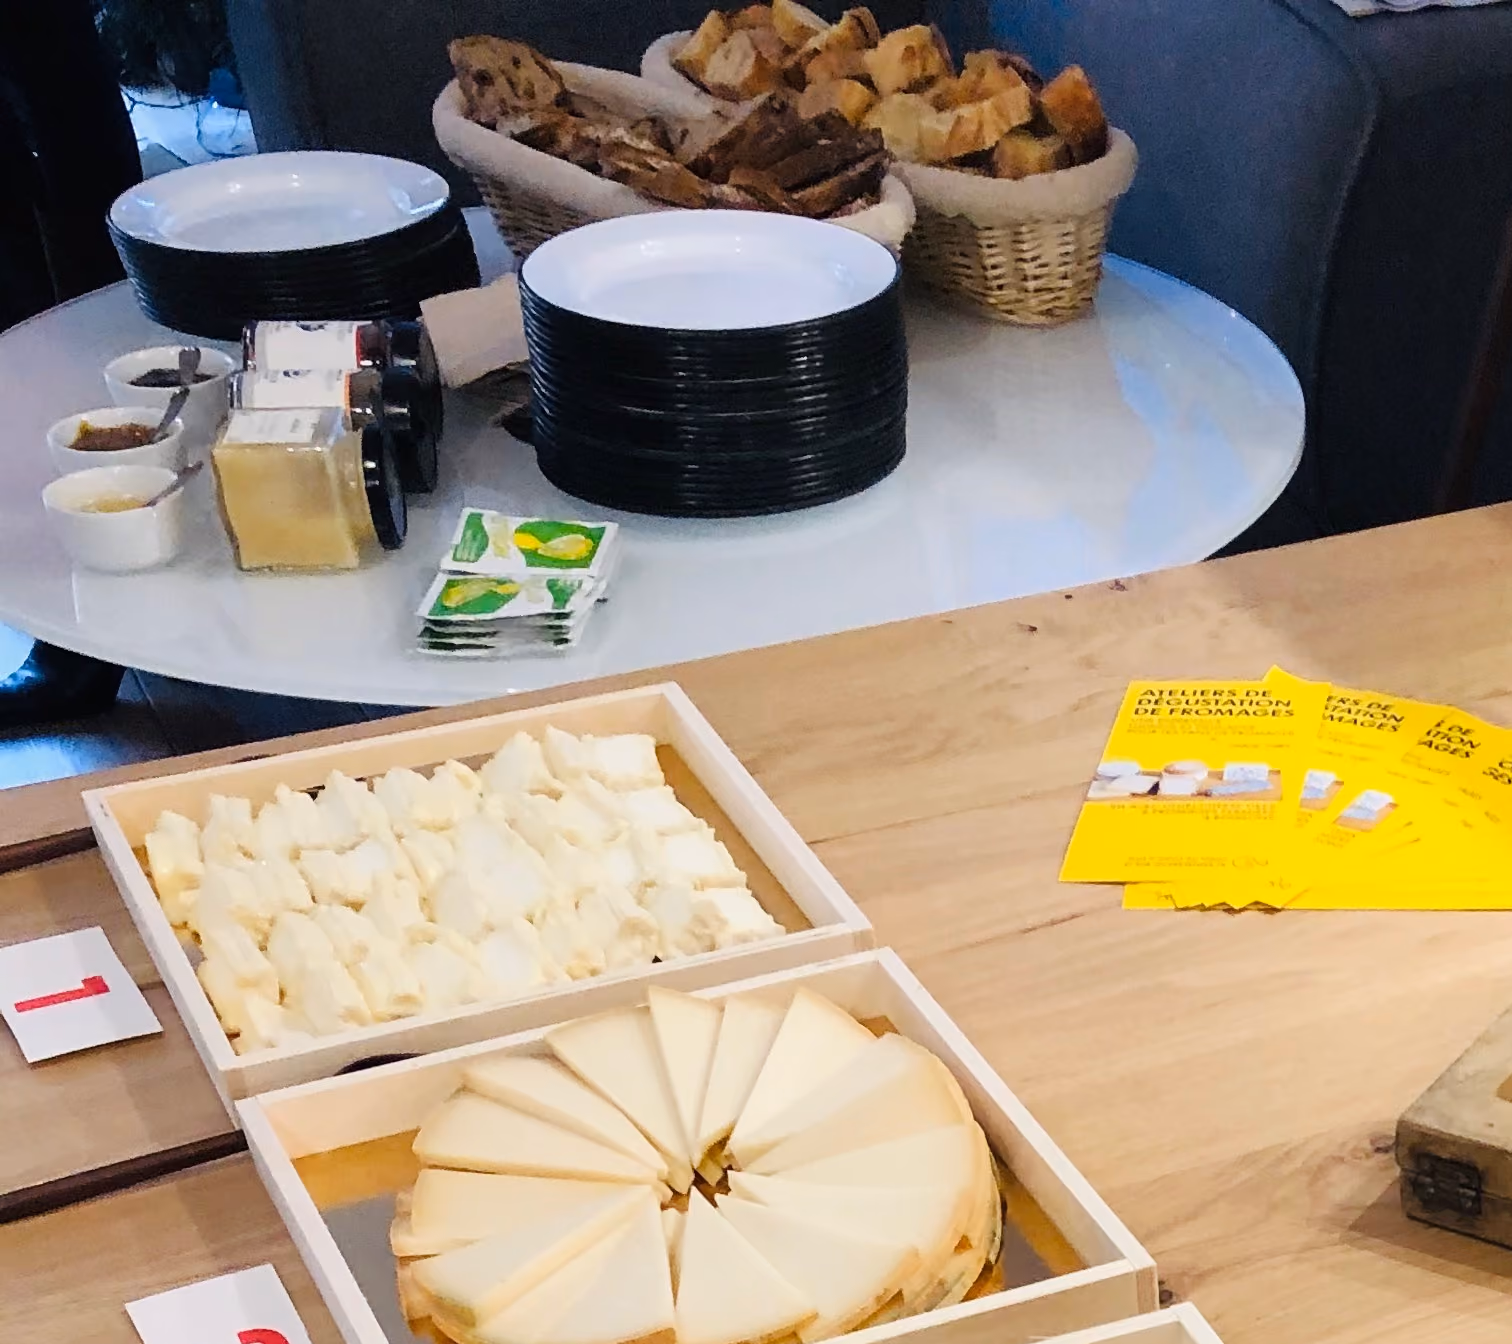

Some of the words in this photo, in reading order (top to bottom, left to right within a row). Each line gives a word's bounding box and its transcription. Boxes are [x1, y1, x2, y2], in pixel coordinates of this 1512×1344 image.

[1140, 689, 1237, 697] ATELIERS
[1245, 689, 1273, 697] DE
[1134, 707, 1162, 716] DE
[1168, 707, 1295, 717] FROMAGES
[15, 976, 110, 1012] 1
